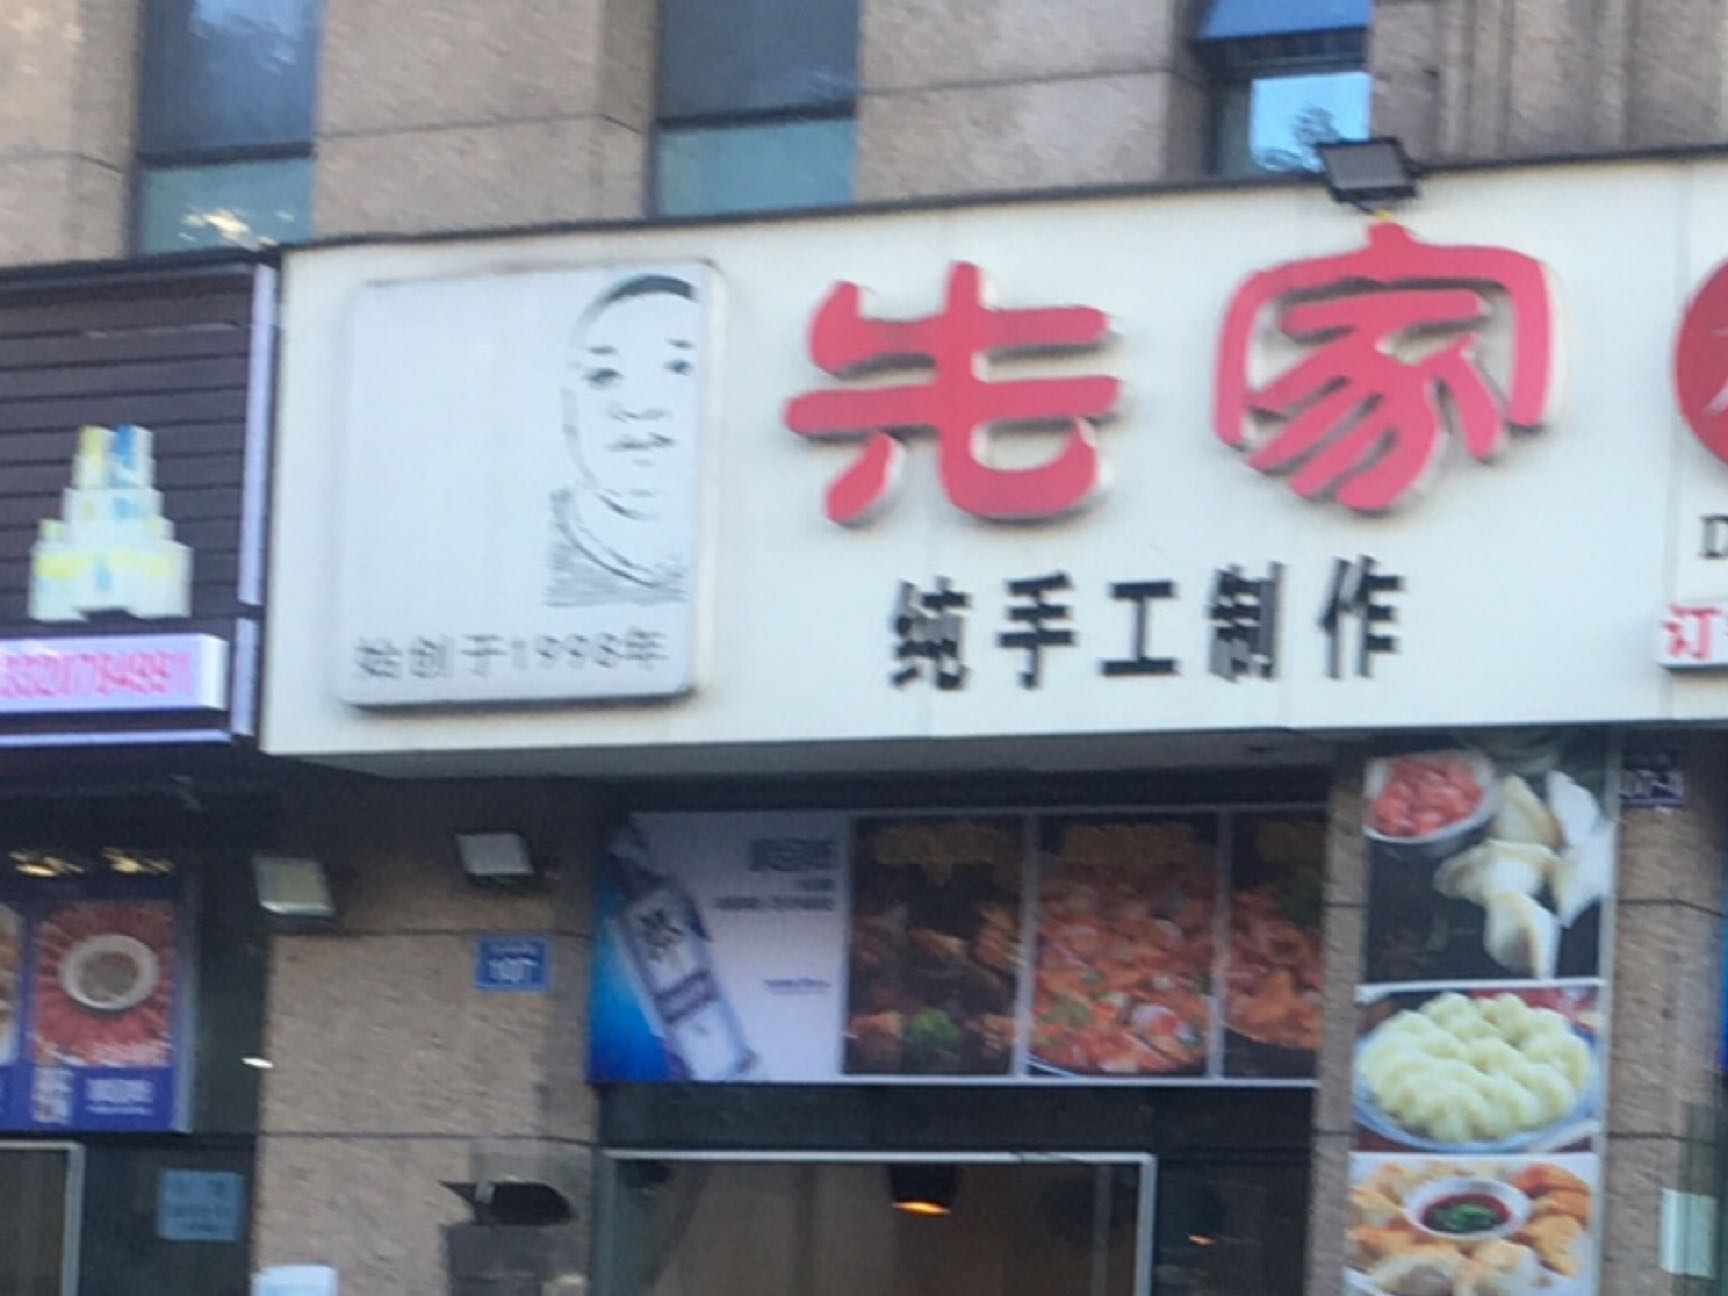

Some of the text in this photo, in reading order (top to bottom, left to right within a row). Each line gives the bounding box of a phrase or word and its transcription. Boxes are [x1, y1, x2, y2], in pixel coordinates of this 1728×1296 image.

[784, 222, 1554, 526] 先家
[889, 555, 1407, 690] 纯手工制作
